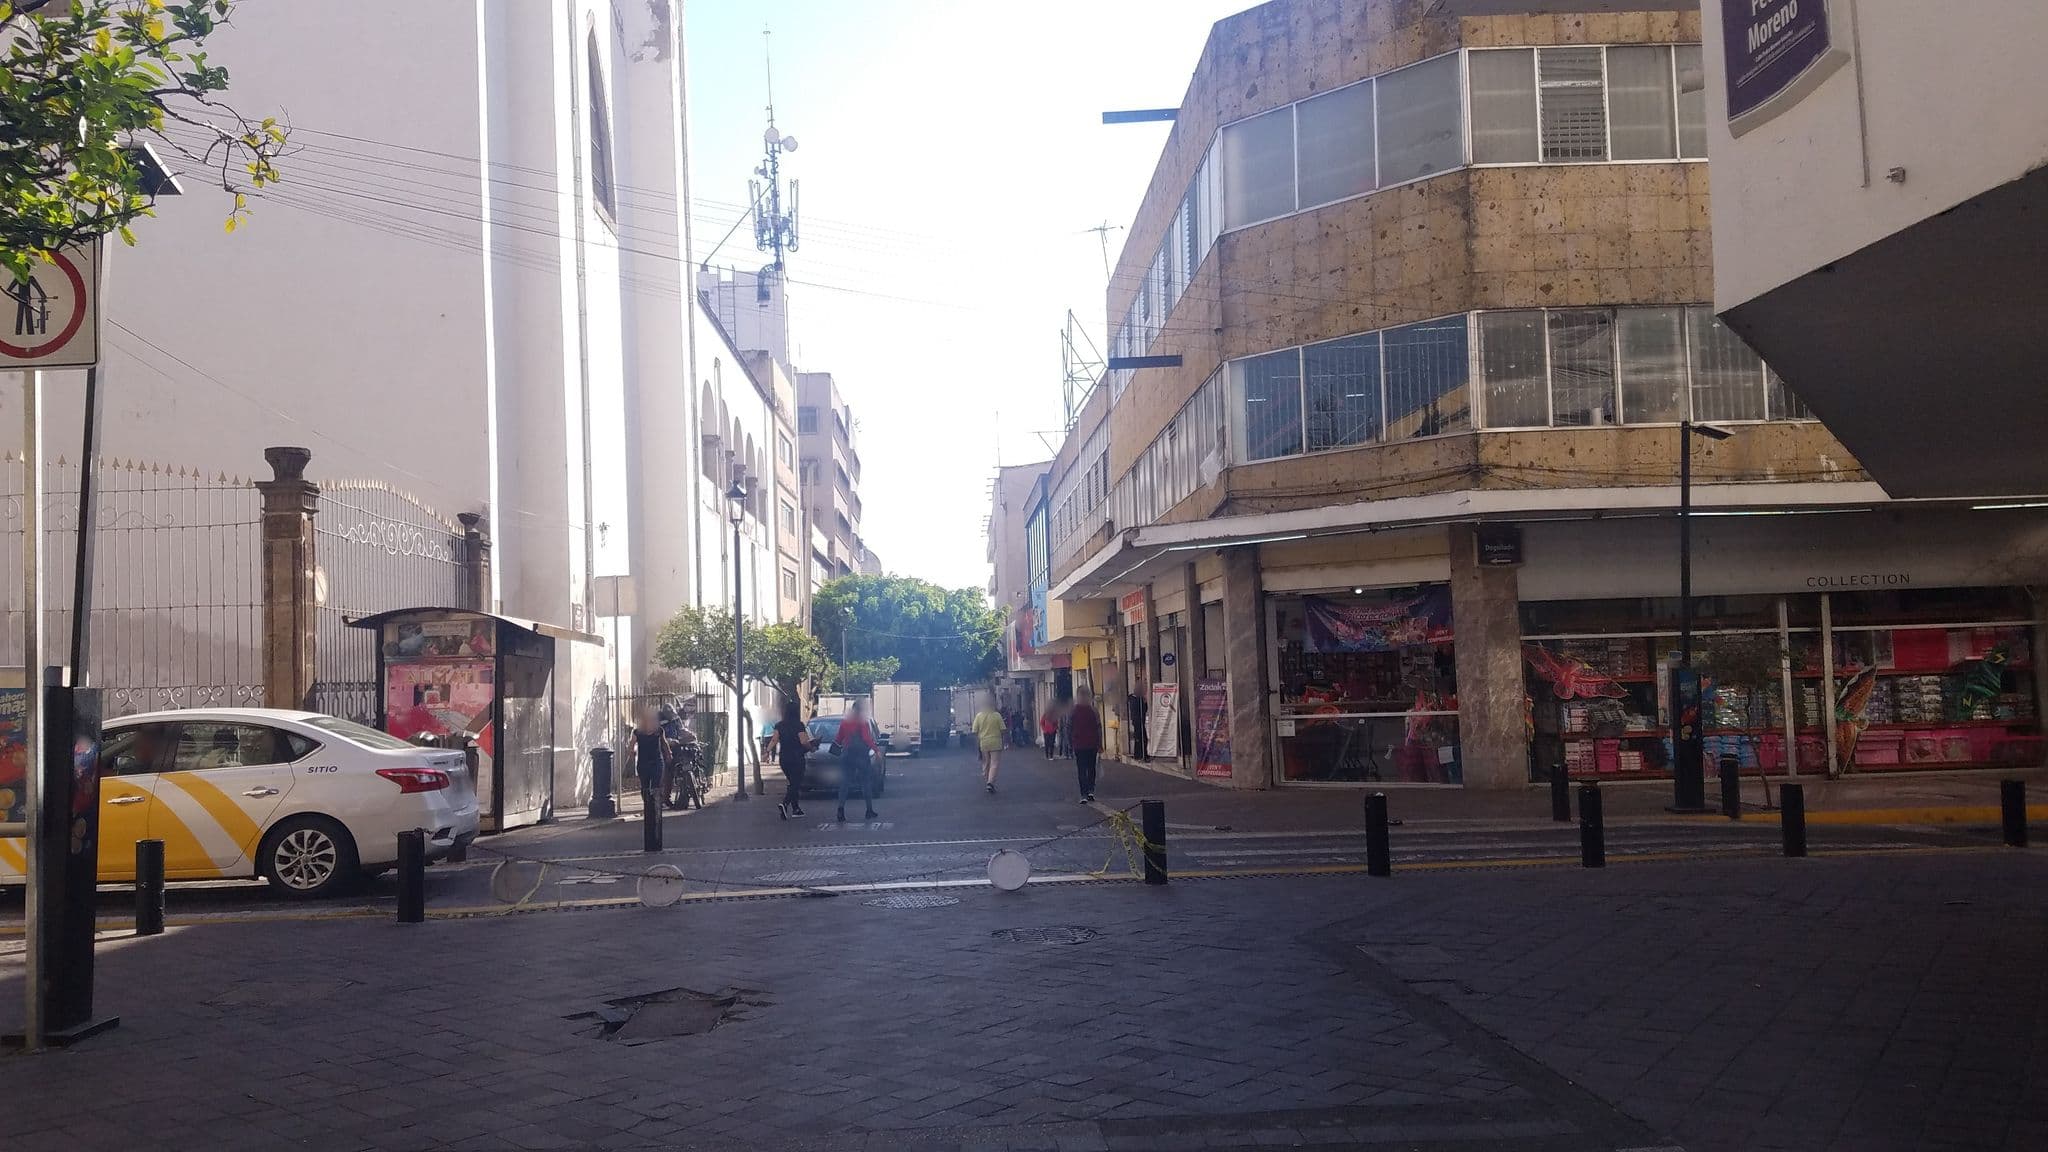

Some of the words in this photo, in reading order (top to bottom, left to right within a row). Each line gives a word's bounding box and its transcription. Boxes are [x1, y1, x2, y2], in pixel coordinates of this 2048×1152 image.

[1748, 0, 1799, 54] Moreno
[1806, 574, 1911, 587] COLLECTION
[308, 765, 338, 773] SITIO
